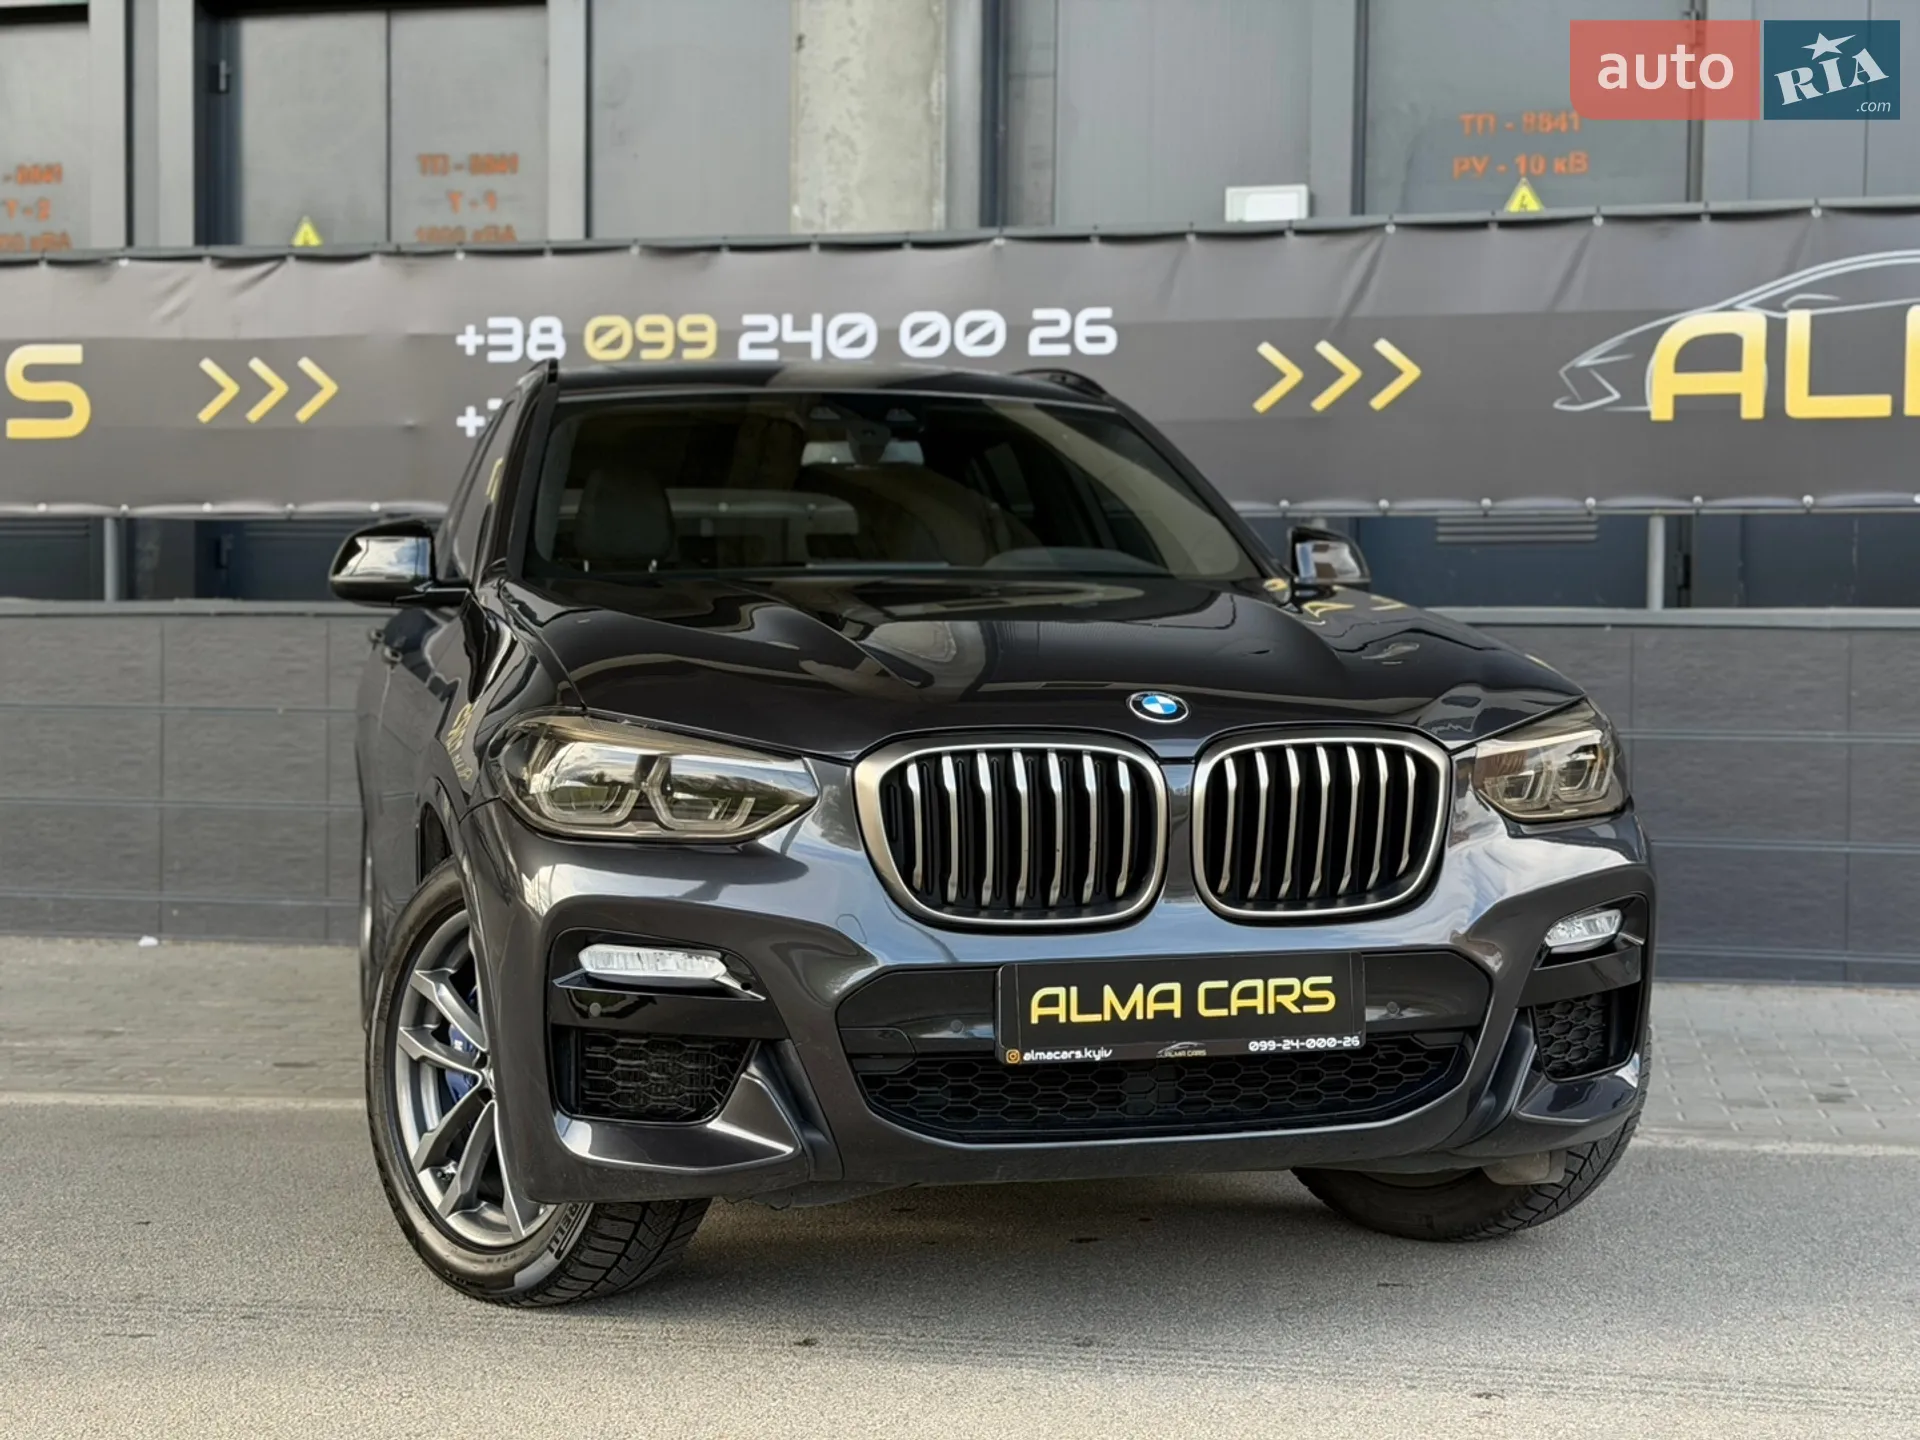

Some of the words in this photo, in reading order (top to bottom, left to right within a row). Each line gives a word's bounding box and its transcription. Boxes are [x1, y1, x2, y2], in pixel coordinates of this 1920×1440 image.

[1515, 152, 1547, 177] 10
[456, 316, 566, 362] +38
[584, 314, 717, 360] 099
[738, 312, 878, 361] 240
[900, 310, 1006, 359] 00
[1028, 307, 1118, 356] 26
[1651, 305, 1920, 421] AL
[5, 344, 91, 438] S
[1030, 982, 1181, 1024] ALMA
[1198, 976, 1336, 1017] CARS
[1023, 1047, 1113, 1062] almacars.kyiv
[1248, 1036, 1360, 1052] 099-24-000-26
